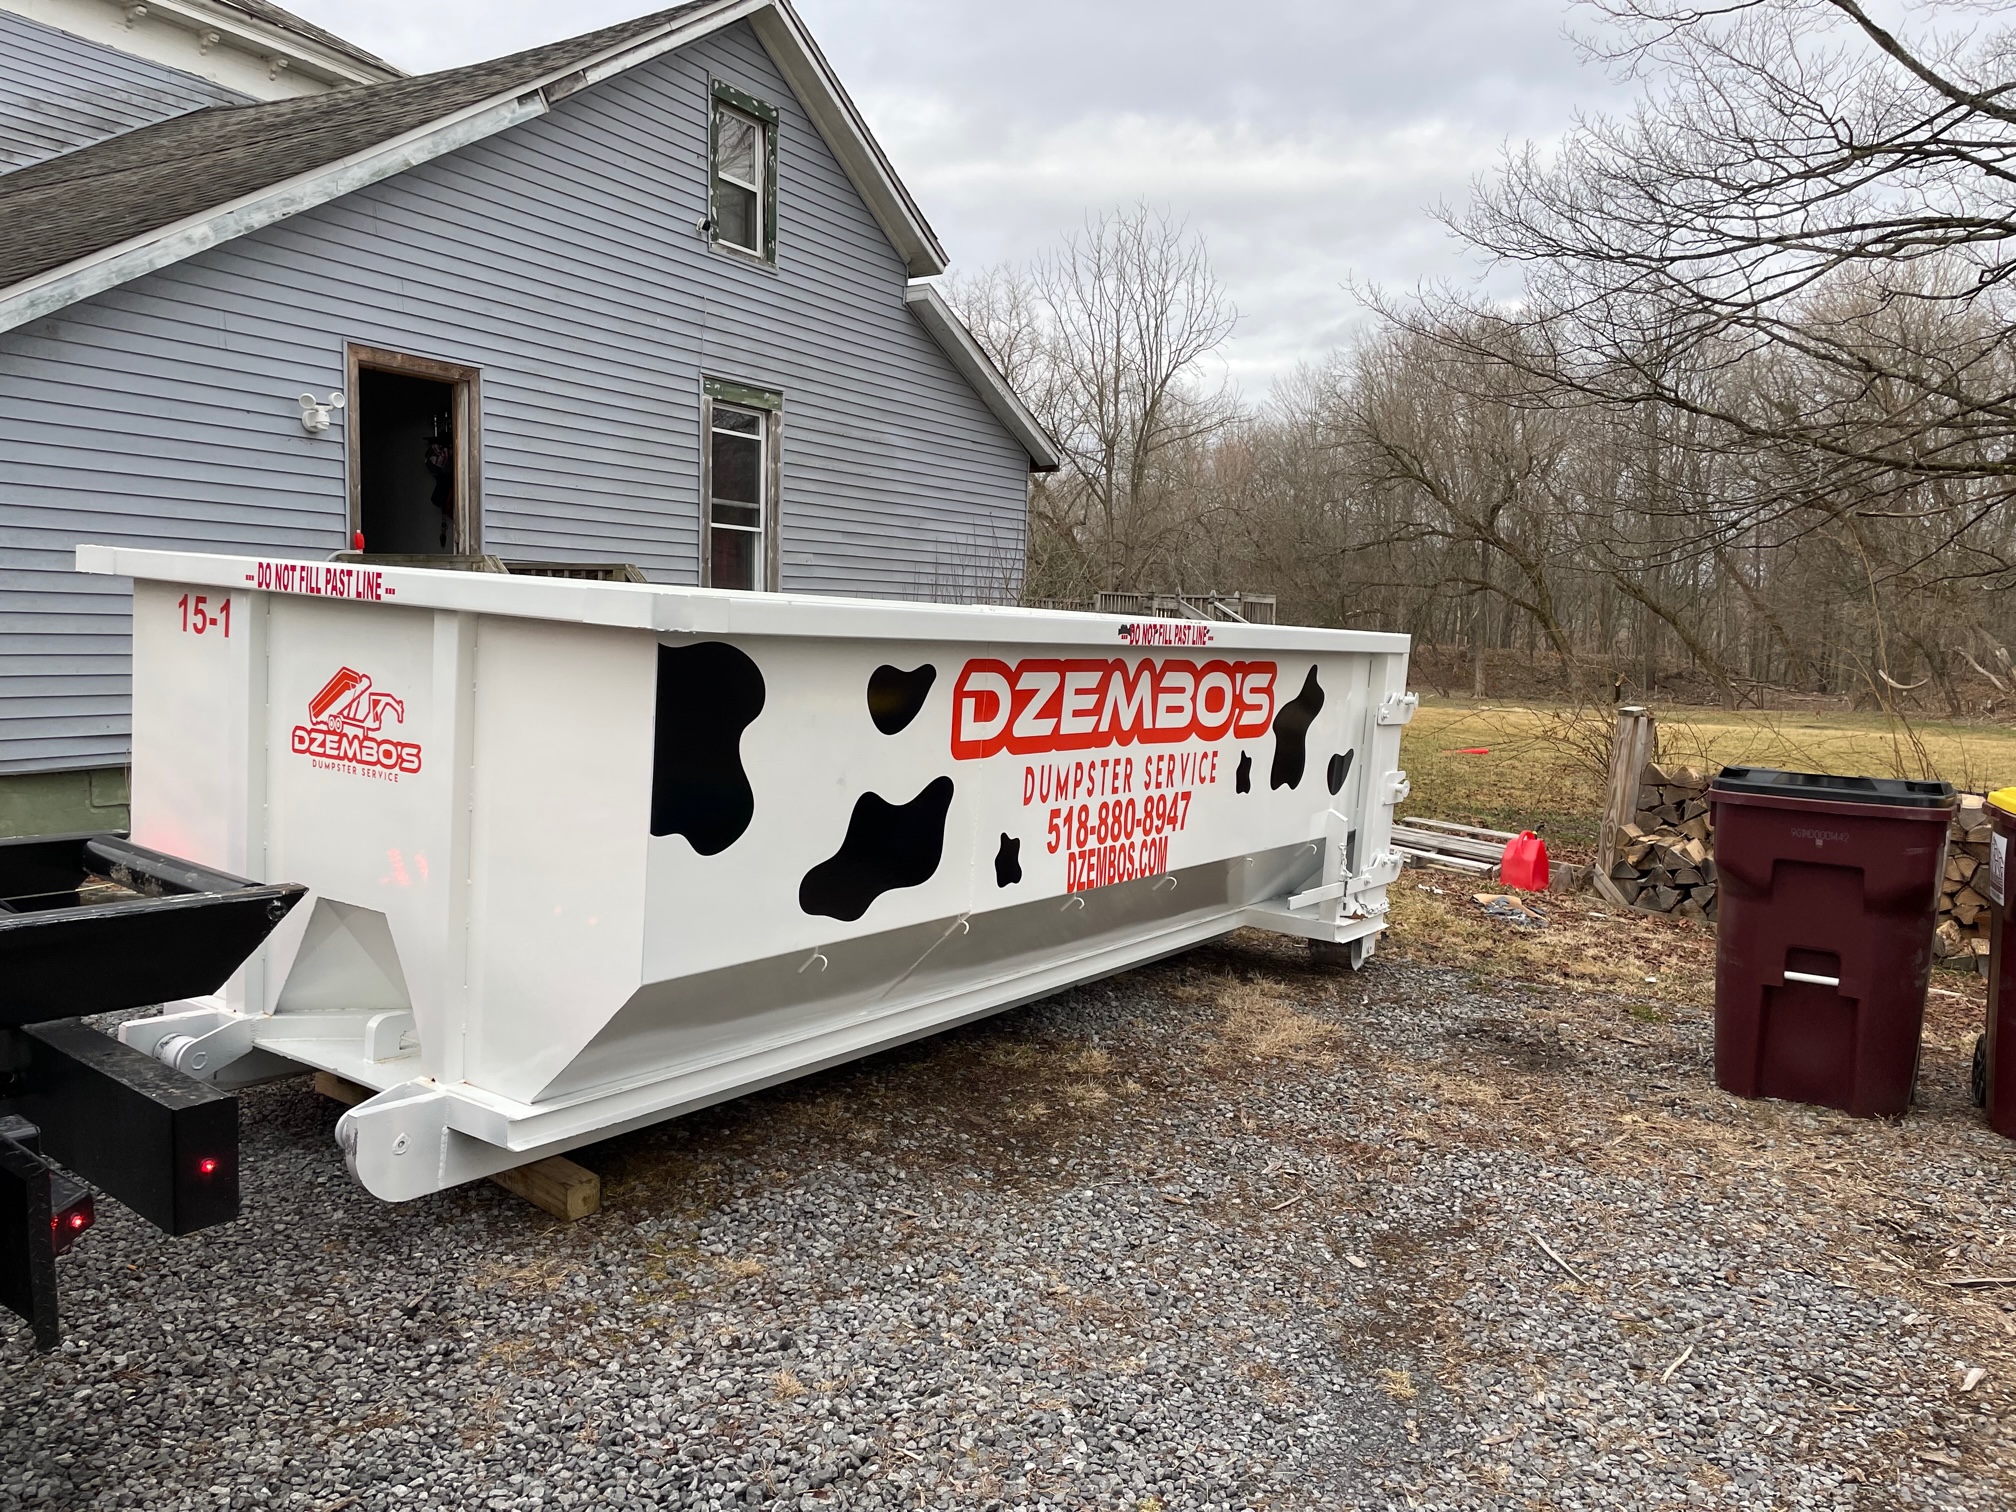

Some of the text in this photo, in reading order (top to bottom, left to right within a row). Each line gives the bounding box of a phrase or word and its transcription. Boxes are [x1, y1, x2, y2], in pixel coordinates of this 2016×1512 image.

[257, 562, 382, 601] DO NOT FILL PAST LINE
[178, 593, 231, 639] 15-1
[1129, 623, 1208, 646] DO NOT FILL PAST LINE
[956, 664, 1275, 748] DZEMBO'S
[293, 727, 421, 772] DZEMBO'S
[312, 759, 399, 783] DUMPSTER SERVICE
[1023, 750, 1219, 806] DUMPSTER SERVICE
[1046, 791, 1192, 855] 518-880-8947
[1067, 835, 1168, 894] DZEMBOS.COM
